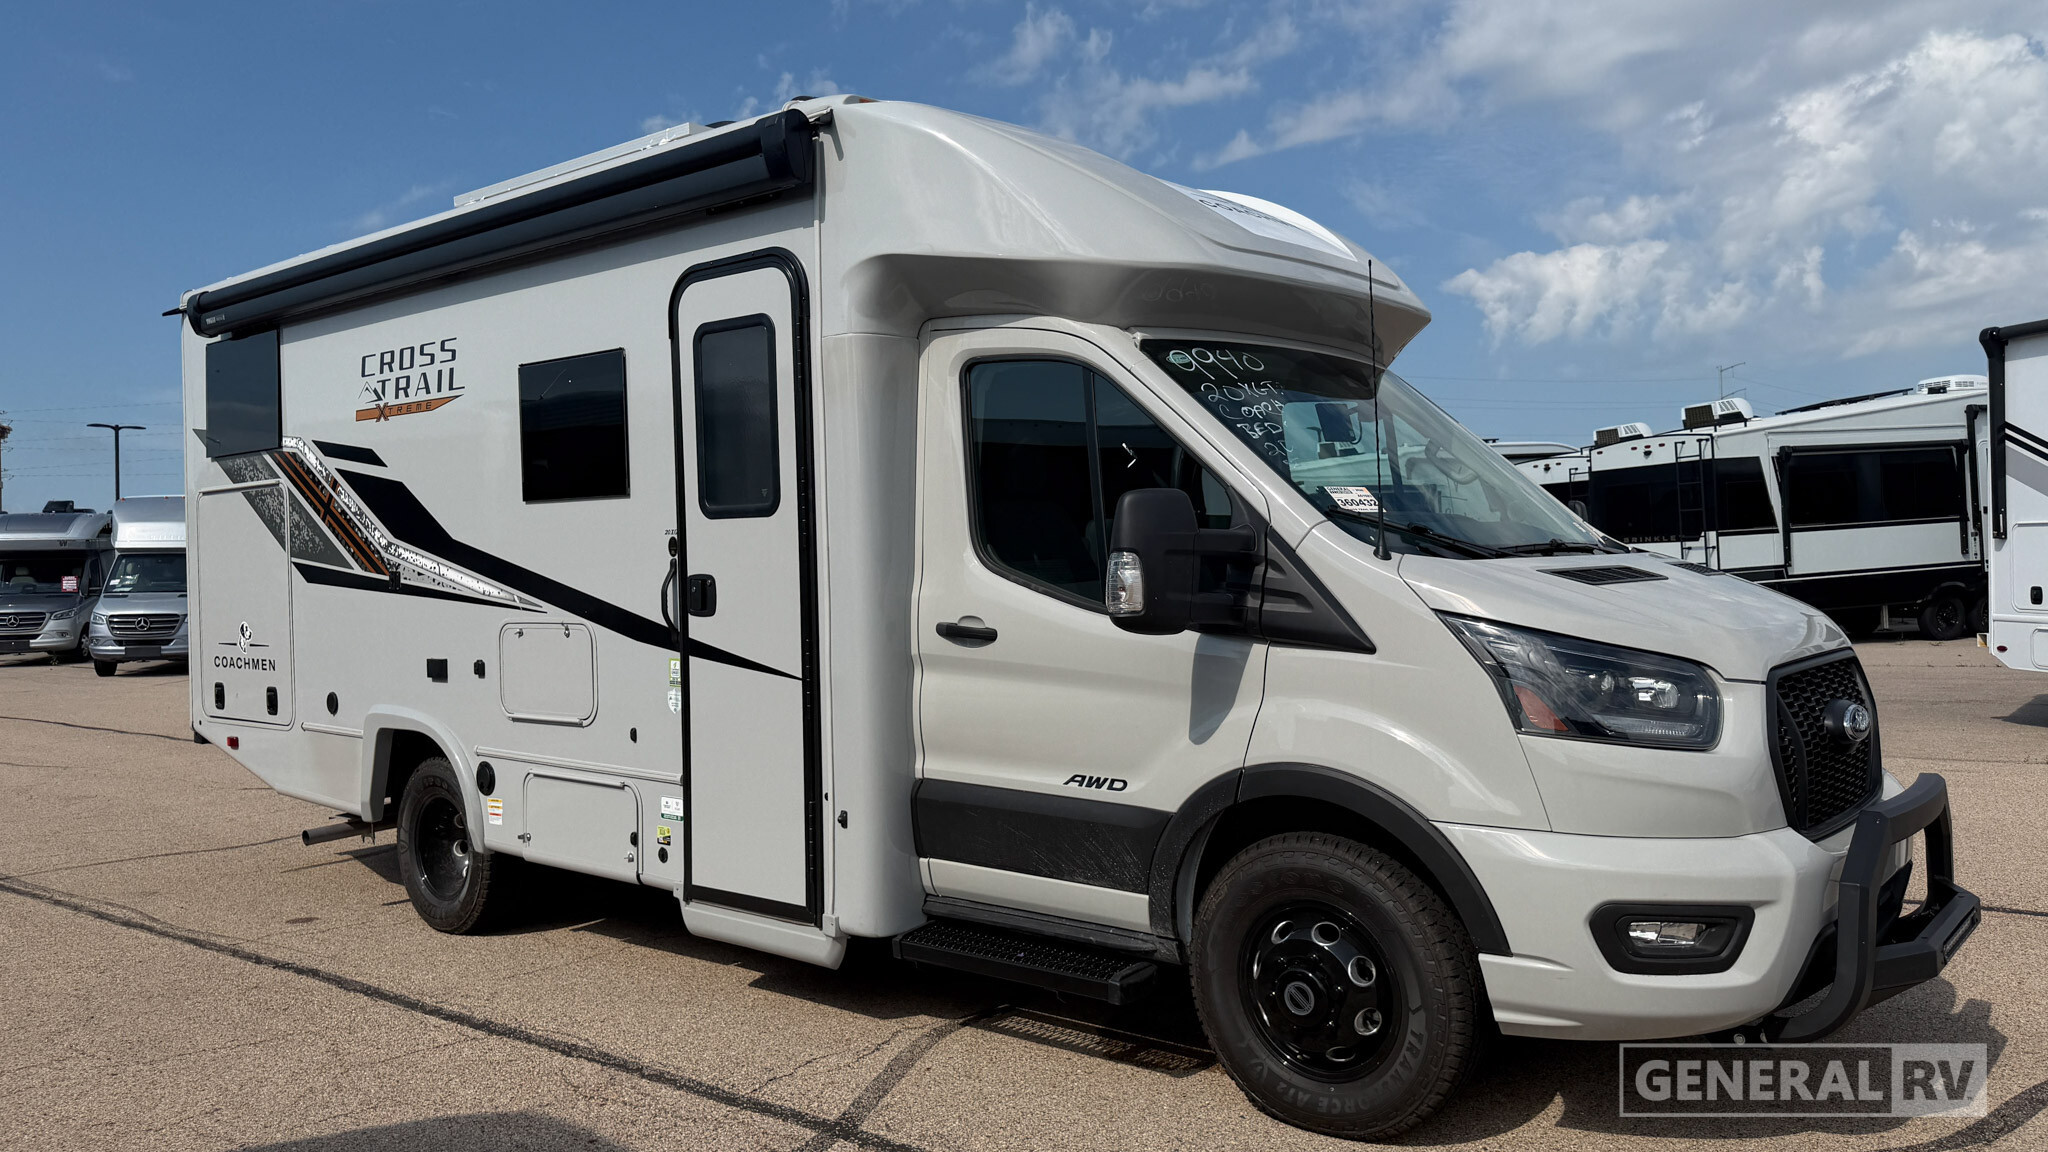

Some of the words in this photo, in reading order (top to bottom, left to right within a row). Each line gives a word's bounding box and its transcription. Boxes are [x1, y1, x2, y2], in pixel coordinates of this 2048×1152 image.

[361, 337, 457, 378] CROSS
[1169, 347, 1265, 380] 9940
[377, 367, 465, 400] TRAIL
[375, 401, 432, 423] XTREME
[1337, 498, 1380, 507] 360432
[213, 655, 276, 671] COACHMEN
[1062, 774, 1128, 792] AWD
